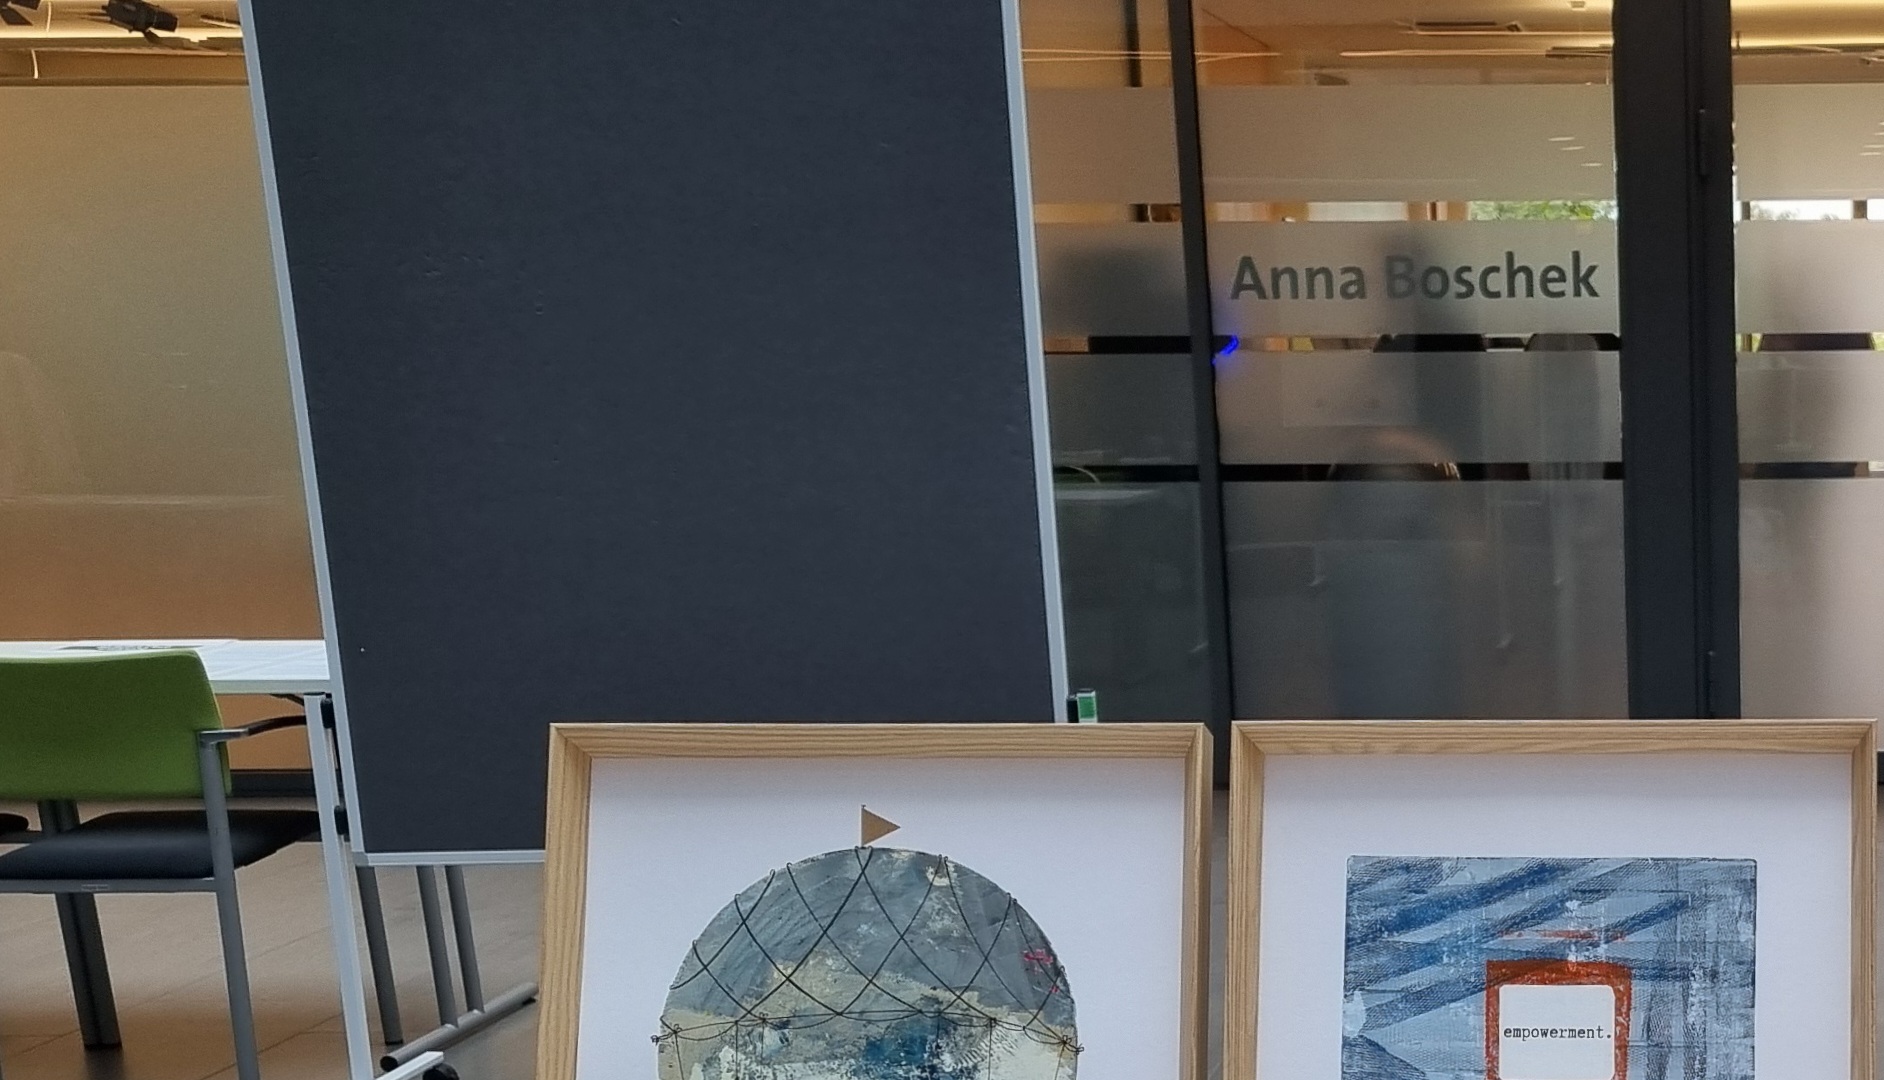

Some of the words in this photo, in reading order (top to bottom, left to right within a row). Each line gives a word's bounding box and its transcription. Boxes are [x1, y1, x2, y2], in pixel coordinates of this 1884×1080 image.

[1230, 256, 1366, 300] Anna
[1385, 250, 1600, 299] Boschek
[1503, 1025, 1612, 1041] empowerment.
